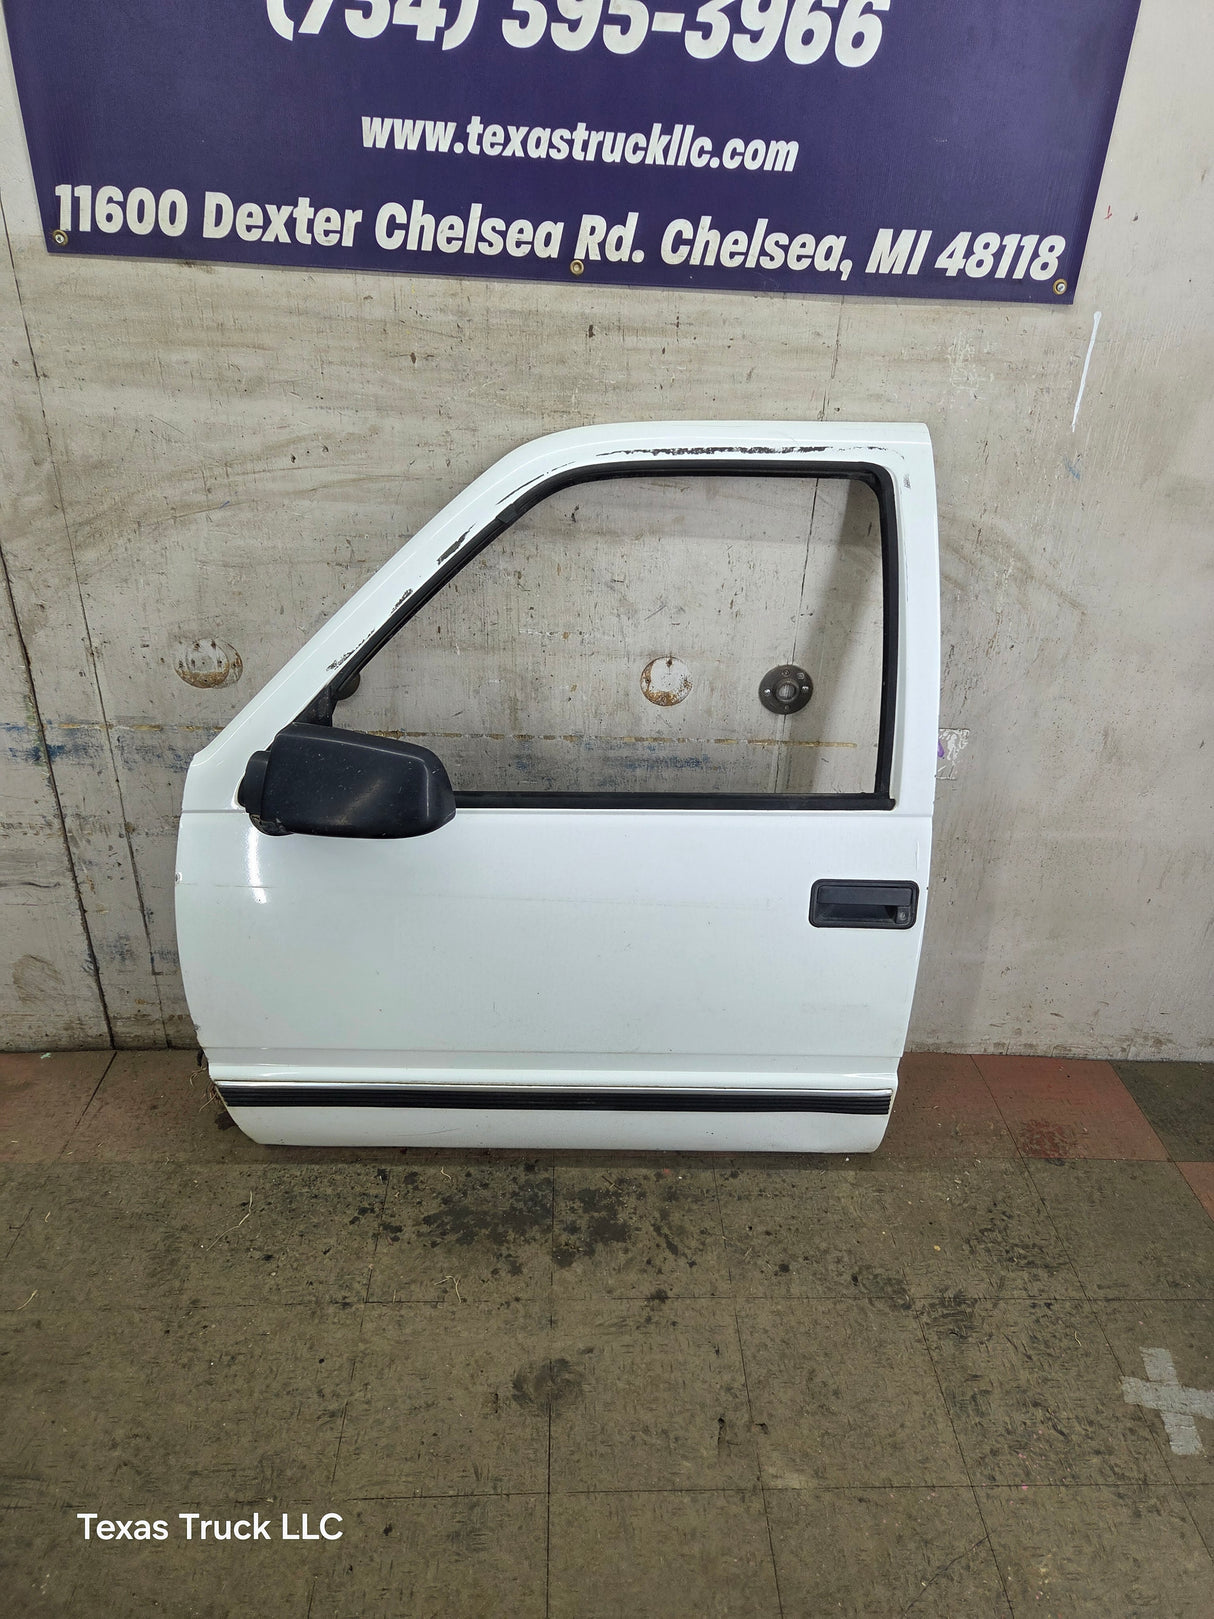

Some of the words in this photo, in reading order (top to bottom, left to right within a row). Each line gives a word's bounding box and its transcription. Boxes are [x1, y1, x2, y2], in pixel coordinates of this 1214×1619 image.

[501, 0, 892, 68] 395-3966
[361, 115, 800, 172] www.texastruckllc.com
[54, 184, 188, 237] 11600
[202, 191, 363, 248] Dexter
[375, 199, 565, 259] Chelsea
[573, 211, 646, 263] Rd.
[660, 217, 853, 281] Chelsea,
[865, 227, 933, 275] MI
[934, 231, 1067, 281] 48118
